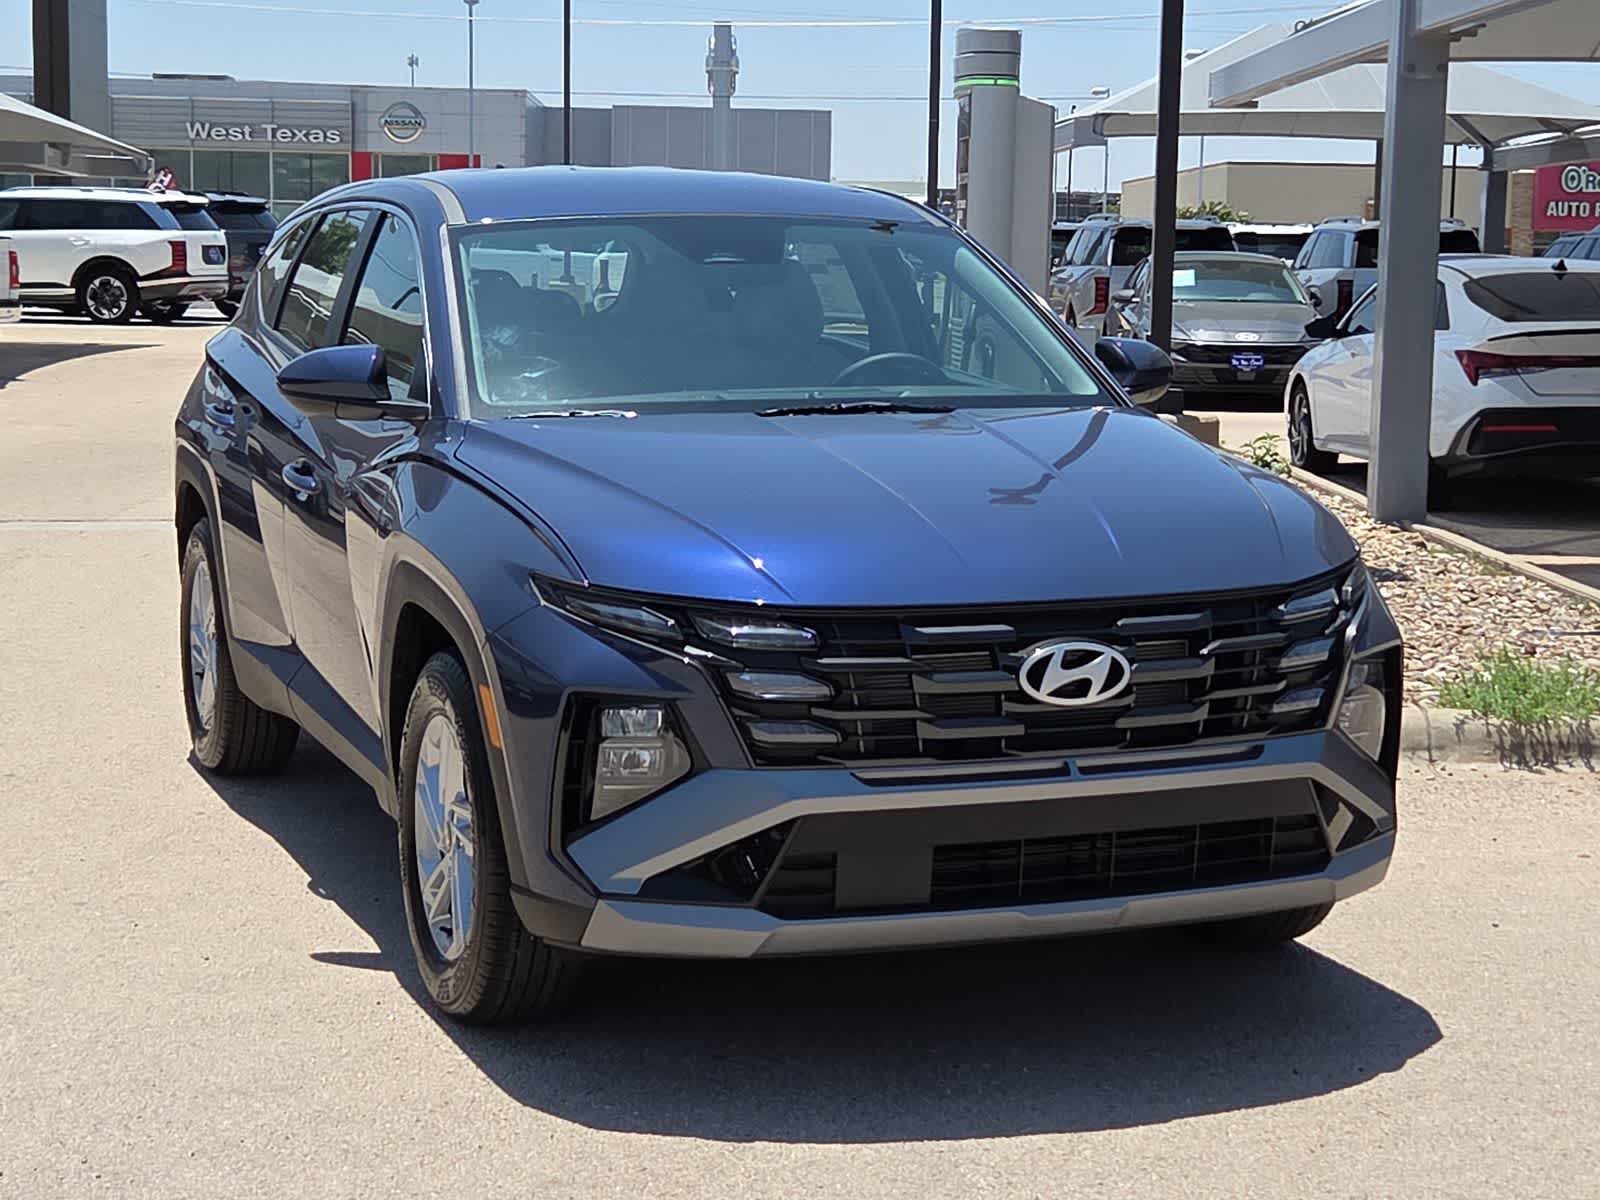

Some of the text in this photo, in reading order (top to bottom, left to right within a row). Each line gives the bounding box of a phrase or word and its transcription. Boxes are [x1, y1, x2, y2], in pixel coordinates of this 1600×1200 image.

[383, 119, 422, 127] NISSAN
[185, 121, 341, 144] West Texas
[1546, 201, 1590, 217] AUTO
